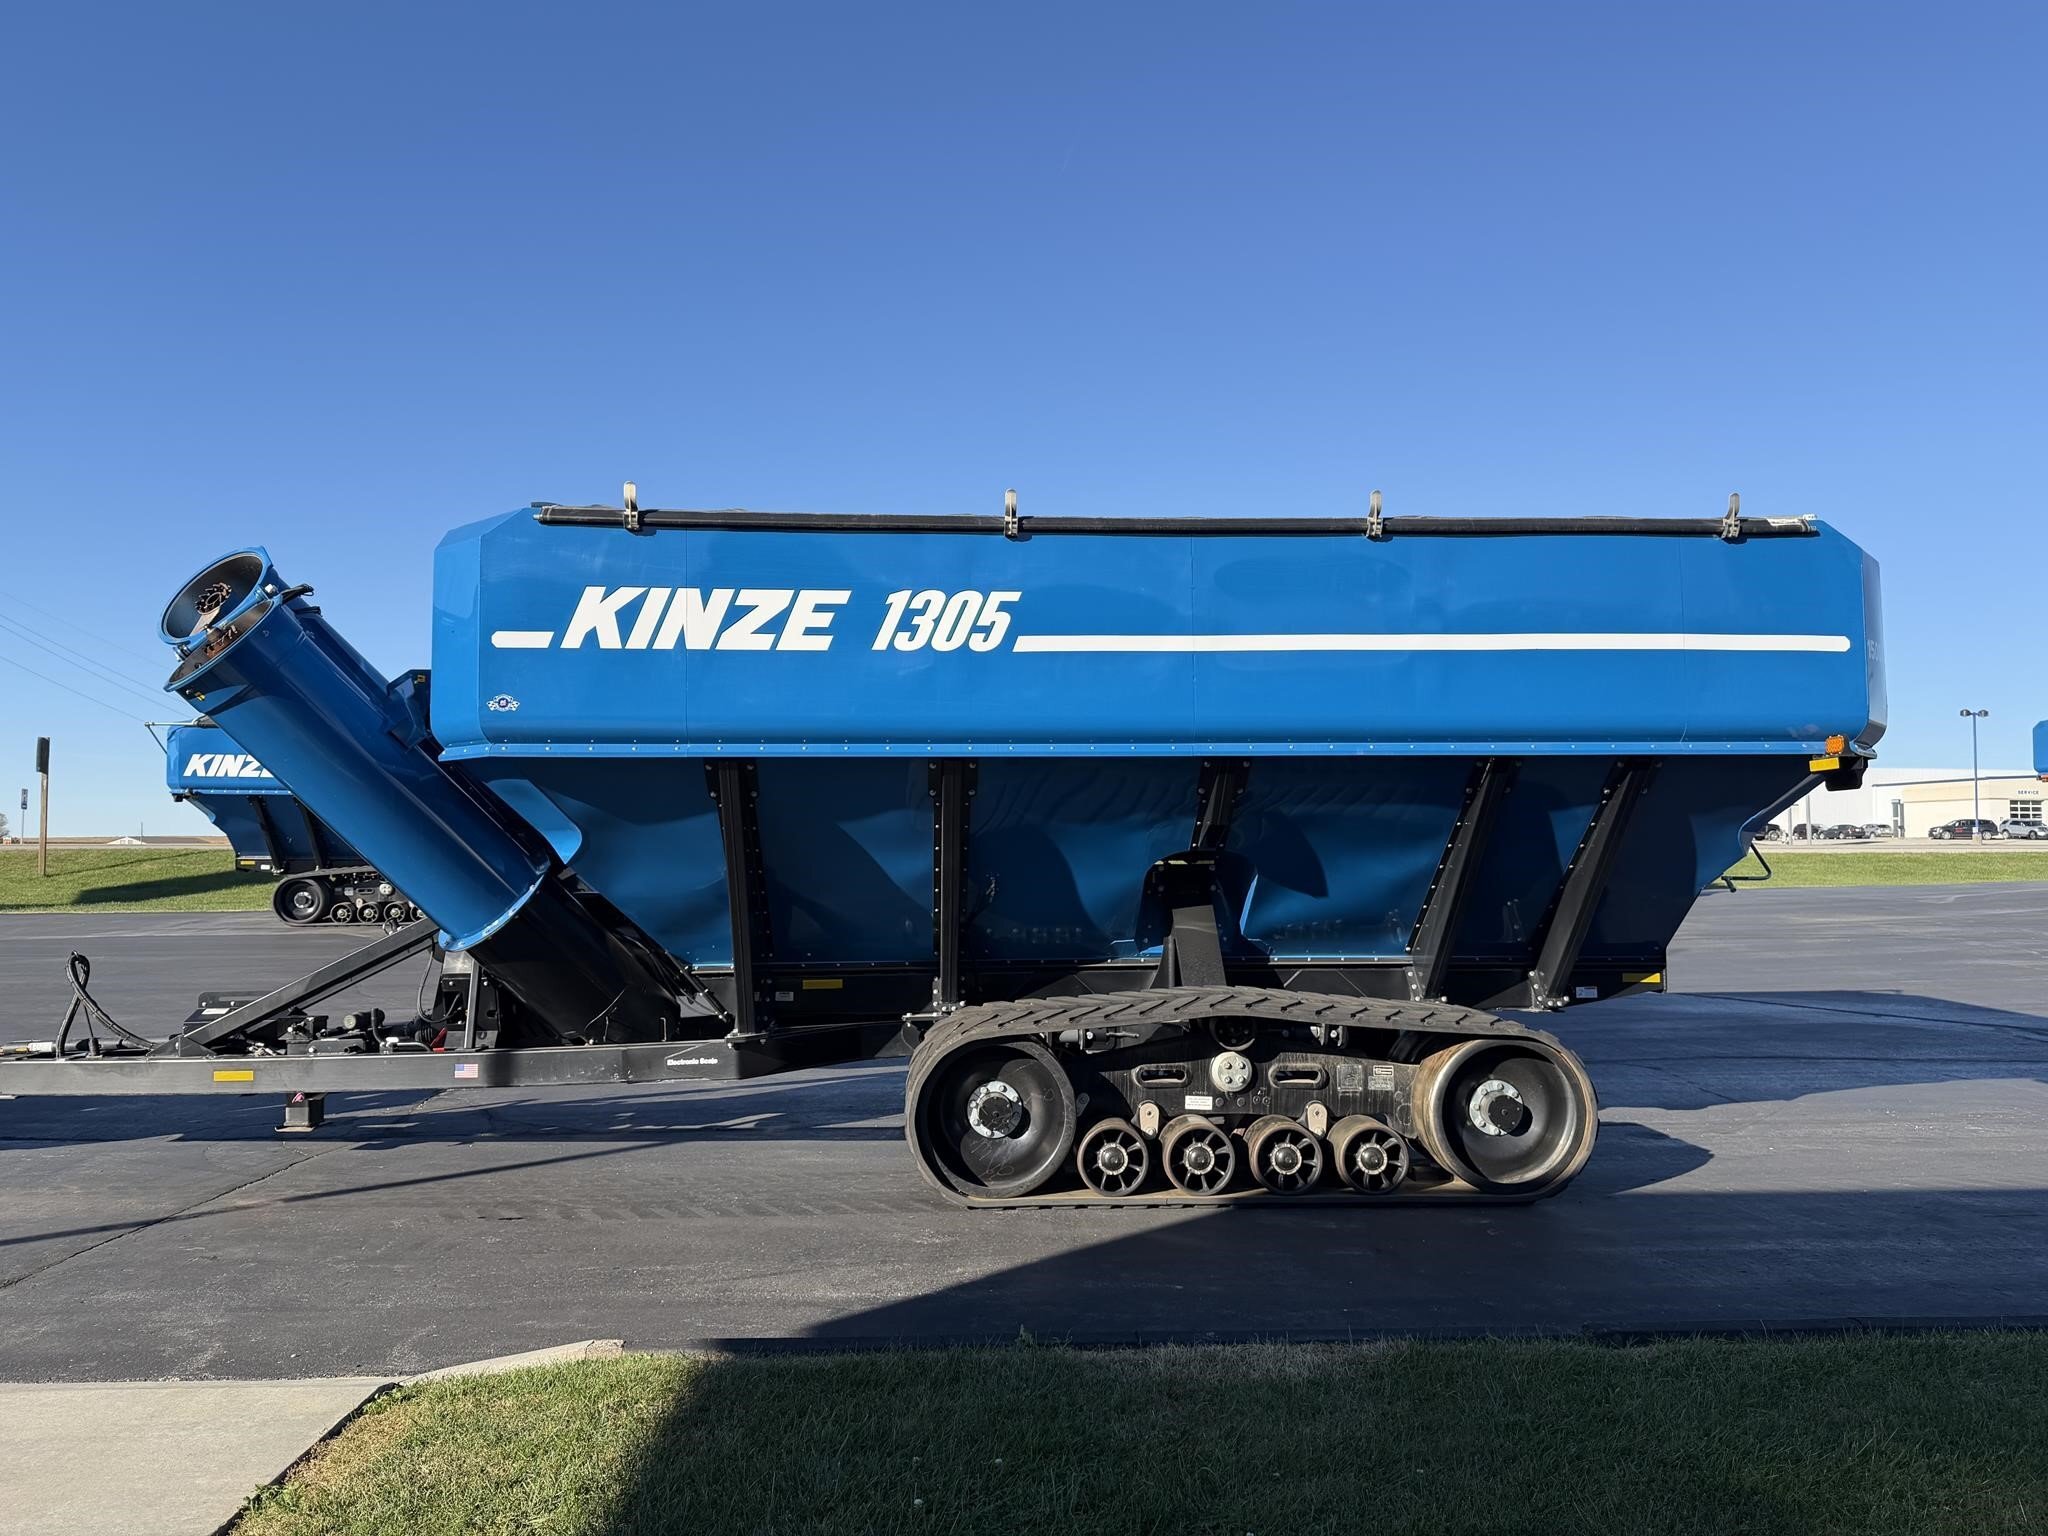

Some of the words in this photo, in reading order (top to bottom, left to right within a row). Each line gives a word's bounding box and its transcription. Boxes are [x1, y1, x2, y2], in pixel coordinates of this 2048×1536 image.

[560, 586, 851, 651] KINZE
[872, 590, 1023, 652] 1305
[182, 754, 274, 777] KINZ
